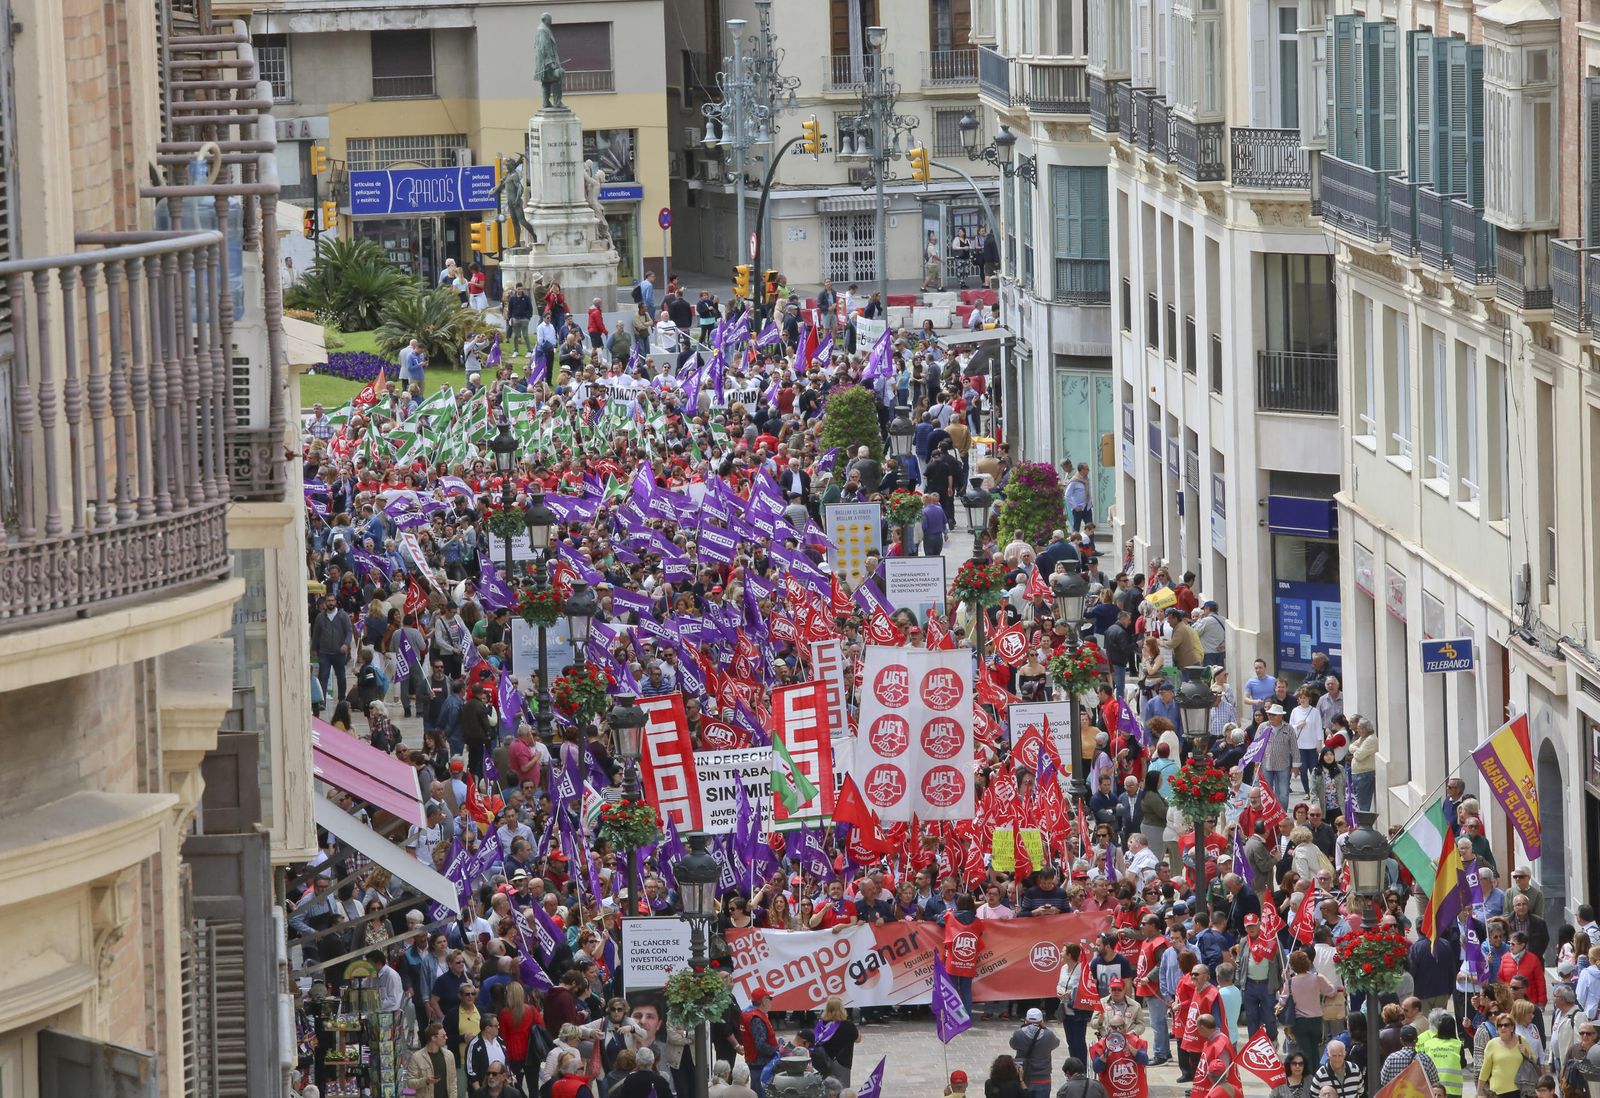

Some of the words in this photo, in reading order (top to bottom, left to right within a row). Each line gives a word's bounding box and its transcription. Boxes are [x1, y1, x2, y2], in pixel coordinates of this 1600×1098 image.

[710, 532, 734, 548] CCOO
[646, 620, 670, 640] CCOO
[774, 622, 796, 636] UGT
[1426, 659, 1470, 670] TELEBANCO
[883, 670, 908, 686] UGT
[928, 674, 953, 690] UGT
[708, 726, 732, 742] UGT
[878, 720, 904, 737] UGT
[930, 722, 955, 738] UGT
[639, 699, 692, 833] CCOO
[698, 770, 720, 782] SIN
[873, 770, 898, 786] UGT
[930, 771, 955, 786] UGT
[1481, 756, 1504, 794] RAFAEL
[706, 786, 736, 802] SIN
[746, 782, 772, 798] MIE
[956, 936, 977, 950] UGT
[733, 942, 770, 970] 2018
[849, 930, 920, 986] ganar
[1034, 946, 1055, 958] UGT
[732, 938, 850, 1000] Tiempo
[980, 960, 1008, 975] dignas
[808, 974, 843, 1002] de
[1253, 1038, 1280, 1068] UGT
[1113, 1062, 1135, 1078] UGT
